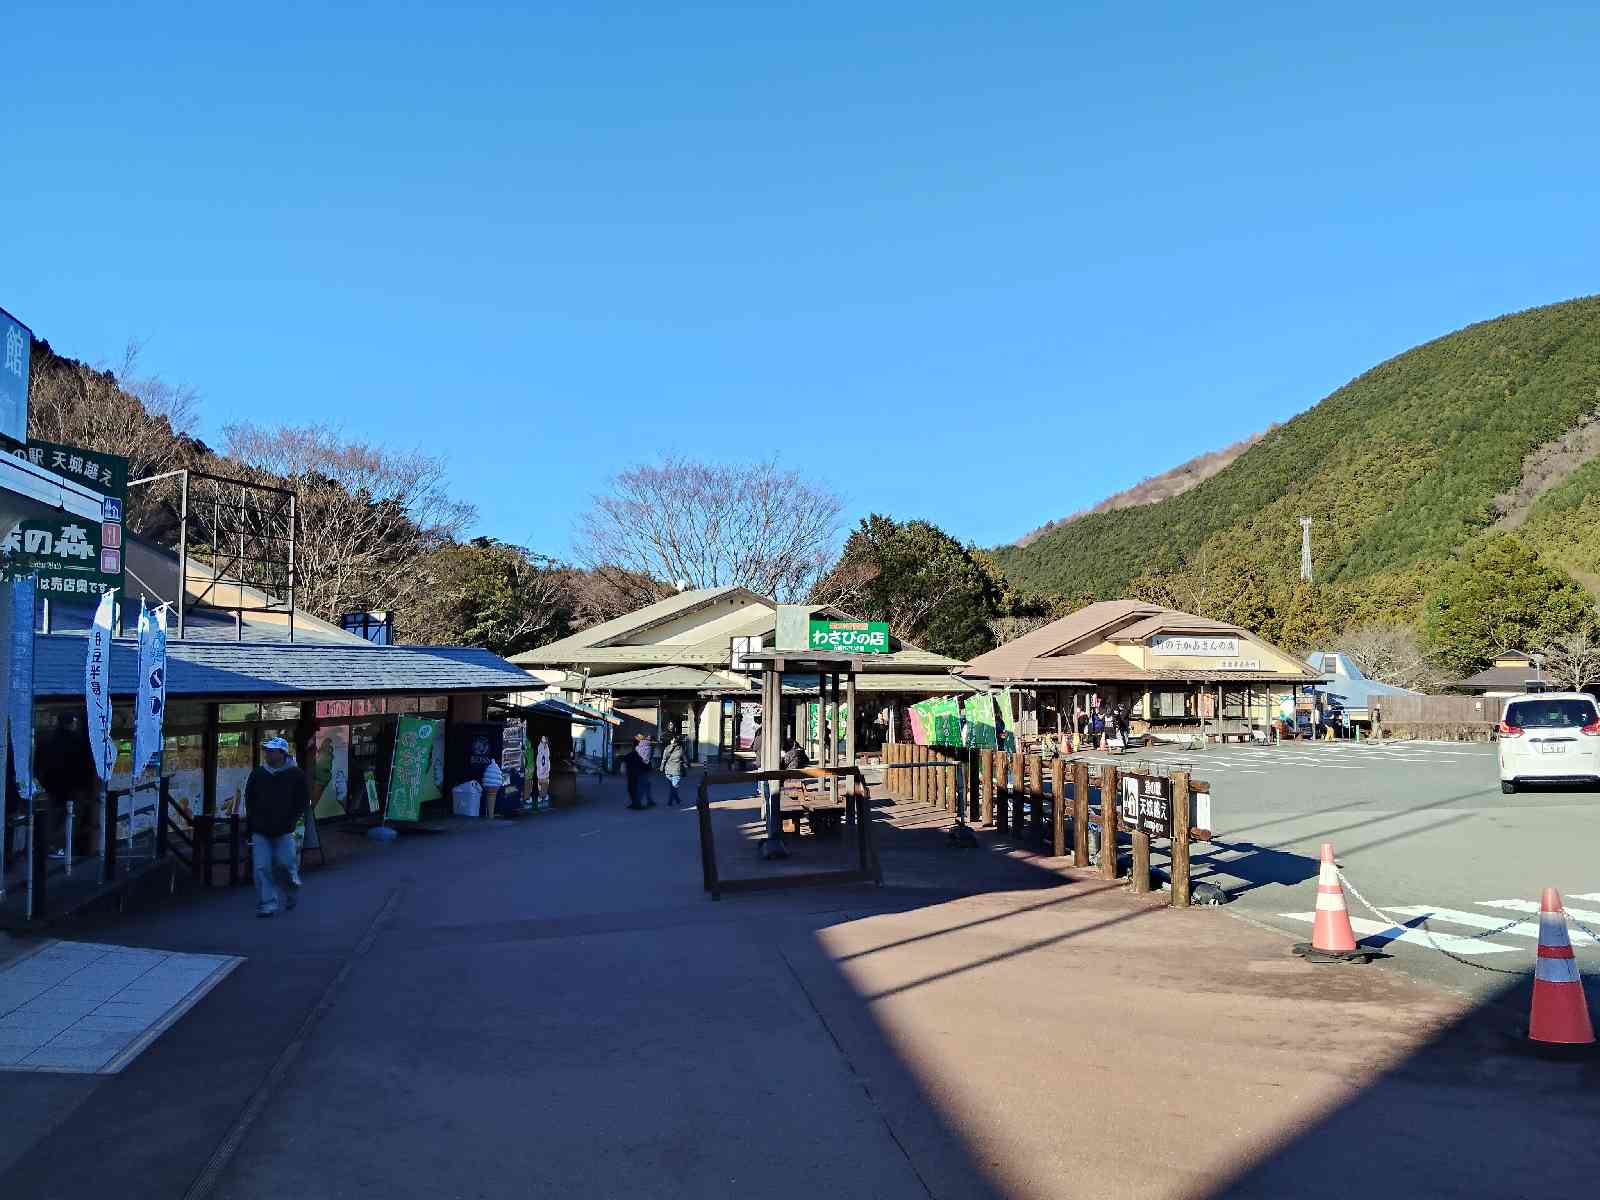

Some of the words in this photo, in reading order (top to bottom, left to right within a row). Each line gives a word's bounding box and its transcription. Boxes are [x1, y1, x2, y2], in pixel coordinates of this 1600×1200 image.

[52, 451, 113, 487] 天城越え
[812, 629, 885, 646] わさびの店
